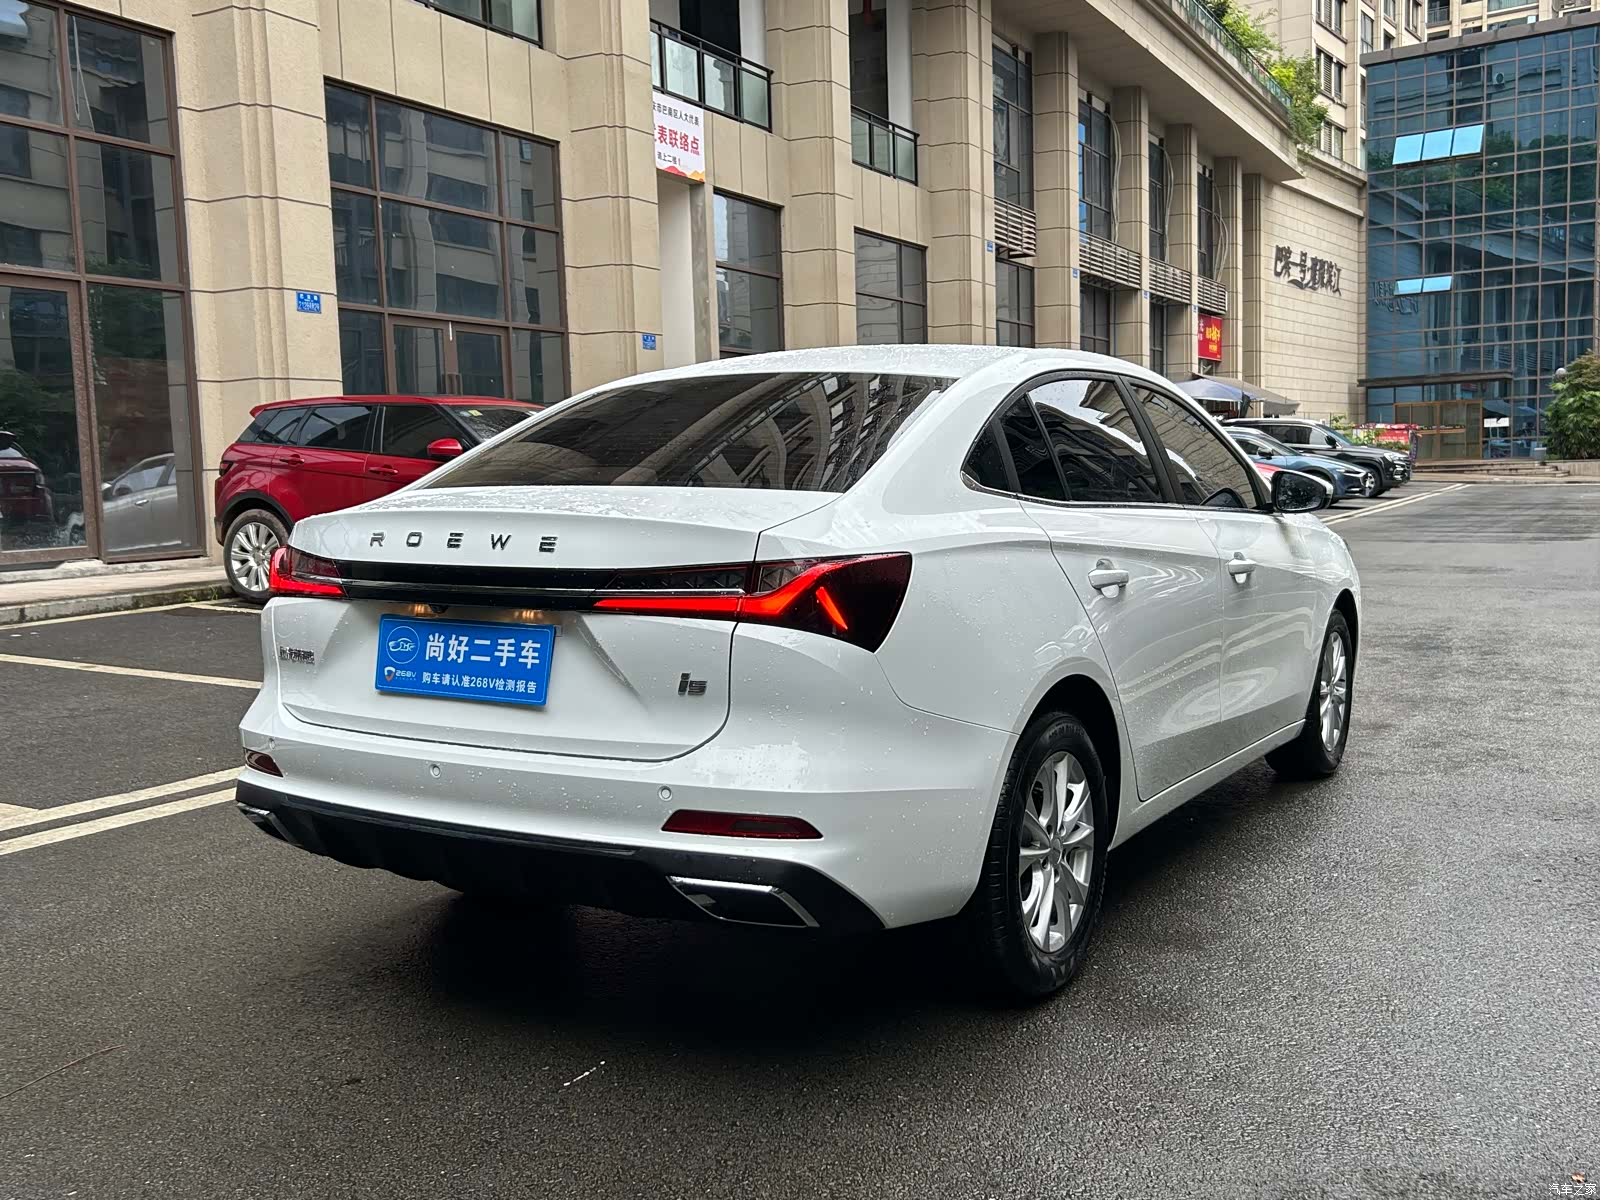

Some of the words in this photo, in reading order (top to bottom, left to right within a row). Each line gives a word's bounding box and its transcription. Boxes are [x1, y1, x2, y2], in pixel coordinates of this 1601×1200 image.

[654, 124, 700, 156] 表联络点
[369, 531, 559, 553] ROEWE
[425, 632, 541, 669] 尚好二手车
[421, 671, 537, 694] 购车请认准268V检测报告
